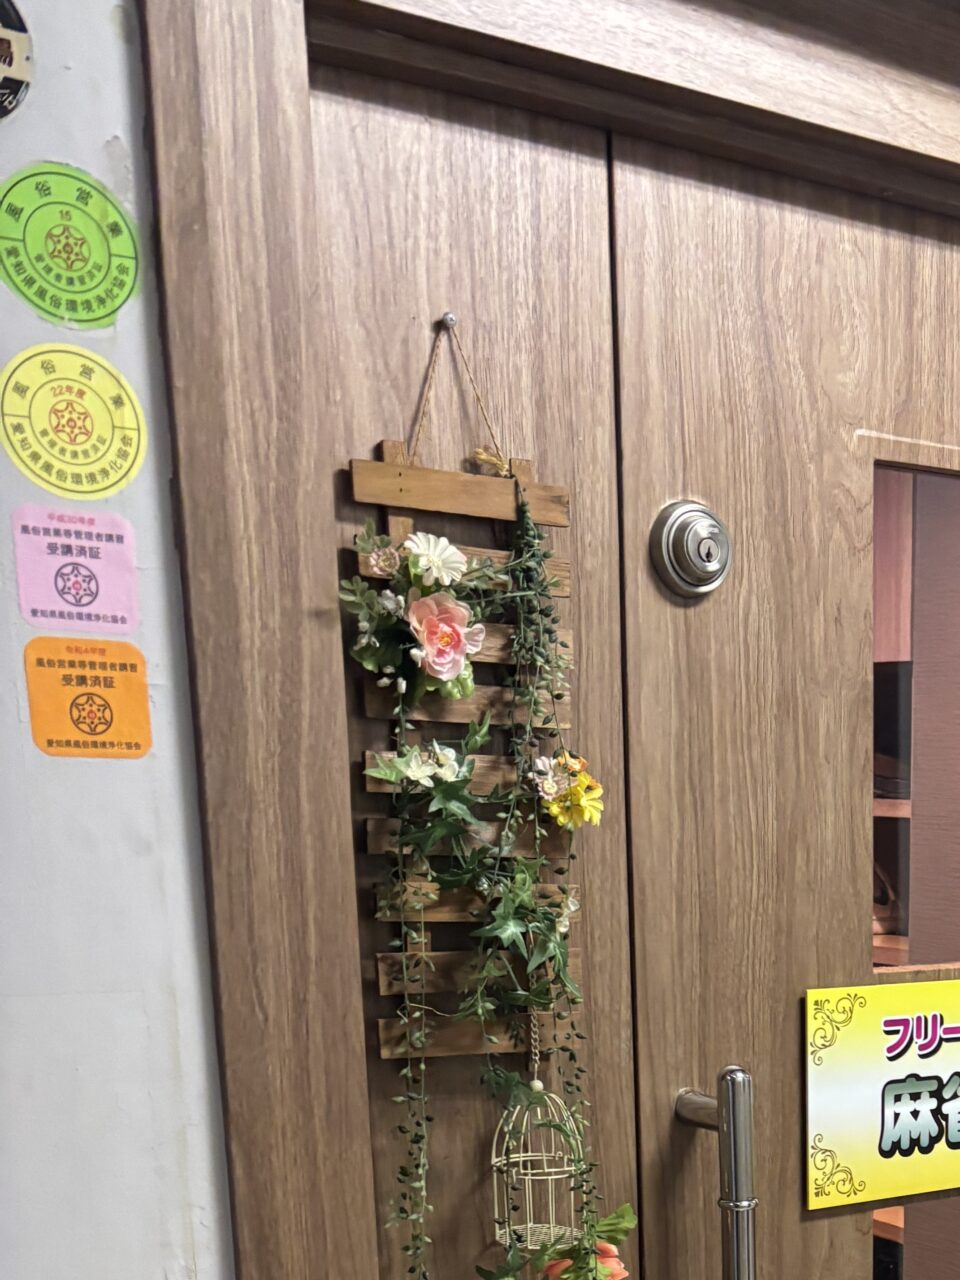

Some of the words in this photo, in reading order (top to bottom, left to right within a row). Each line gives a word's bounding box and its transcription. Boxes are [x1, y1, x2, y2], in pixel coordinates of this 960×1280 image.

[12, 359, 125, 410] 風俗営業
[46, 542, 102, 560] 受講済証
[61, 674, 116, 689] 受講済証
